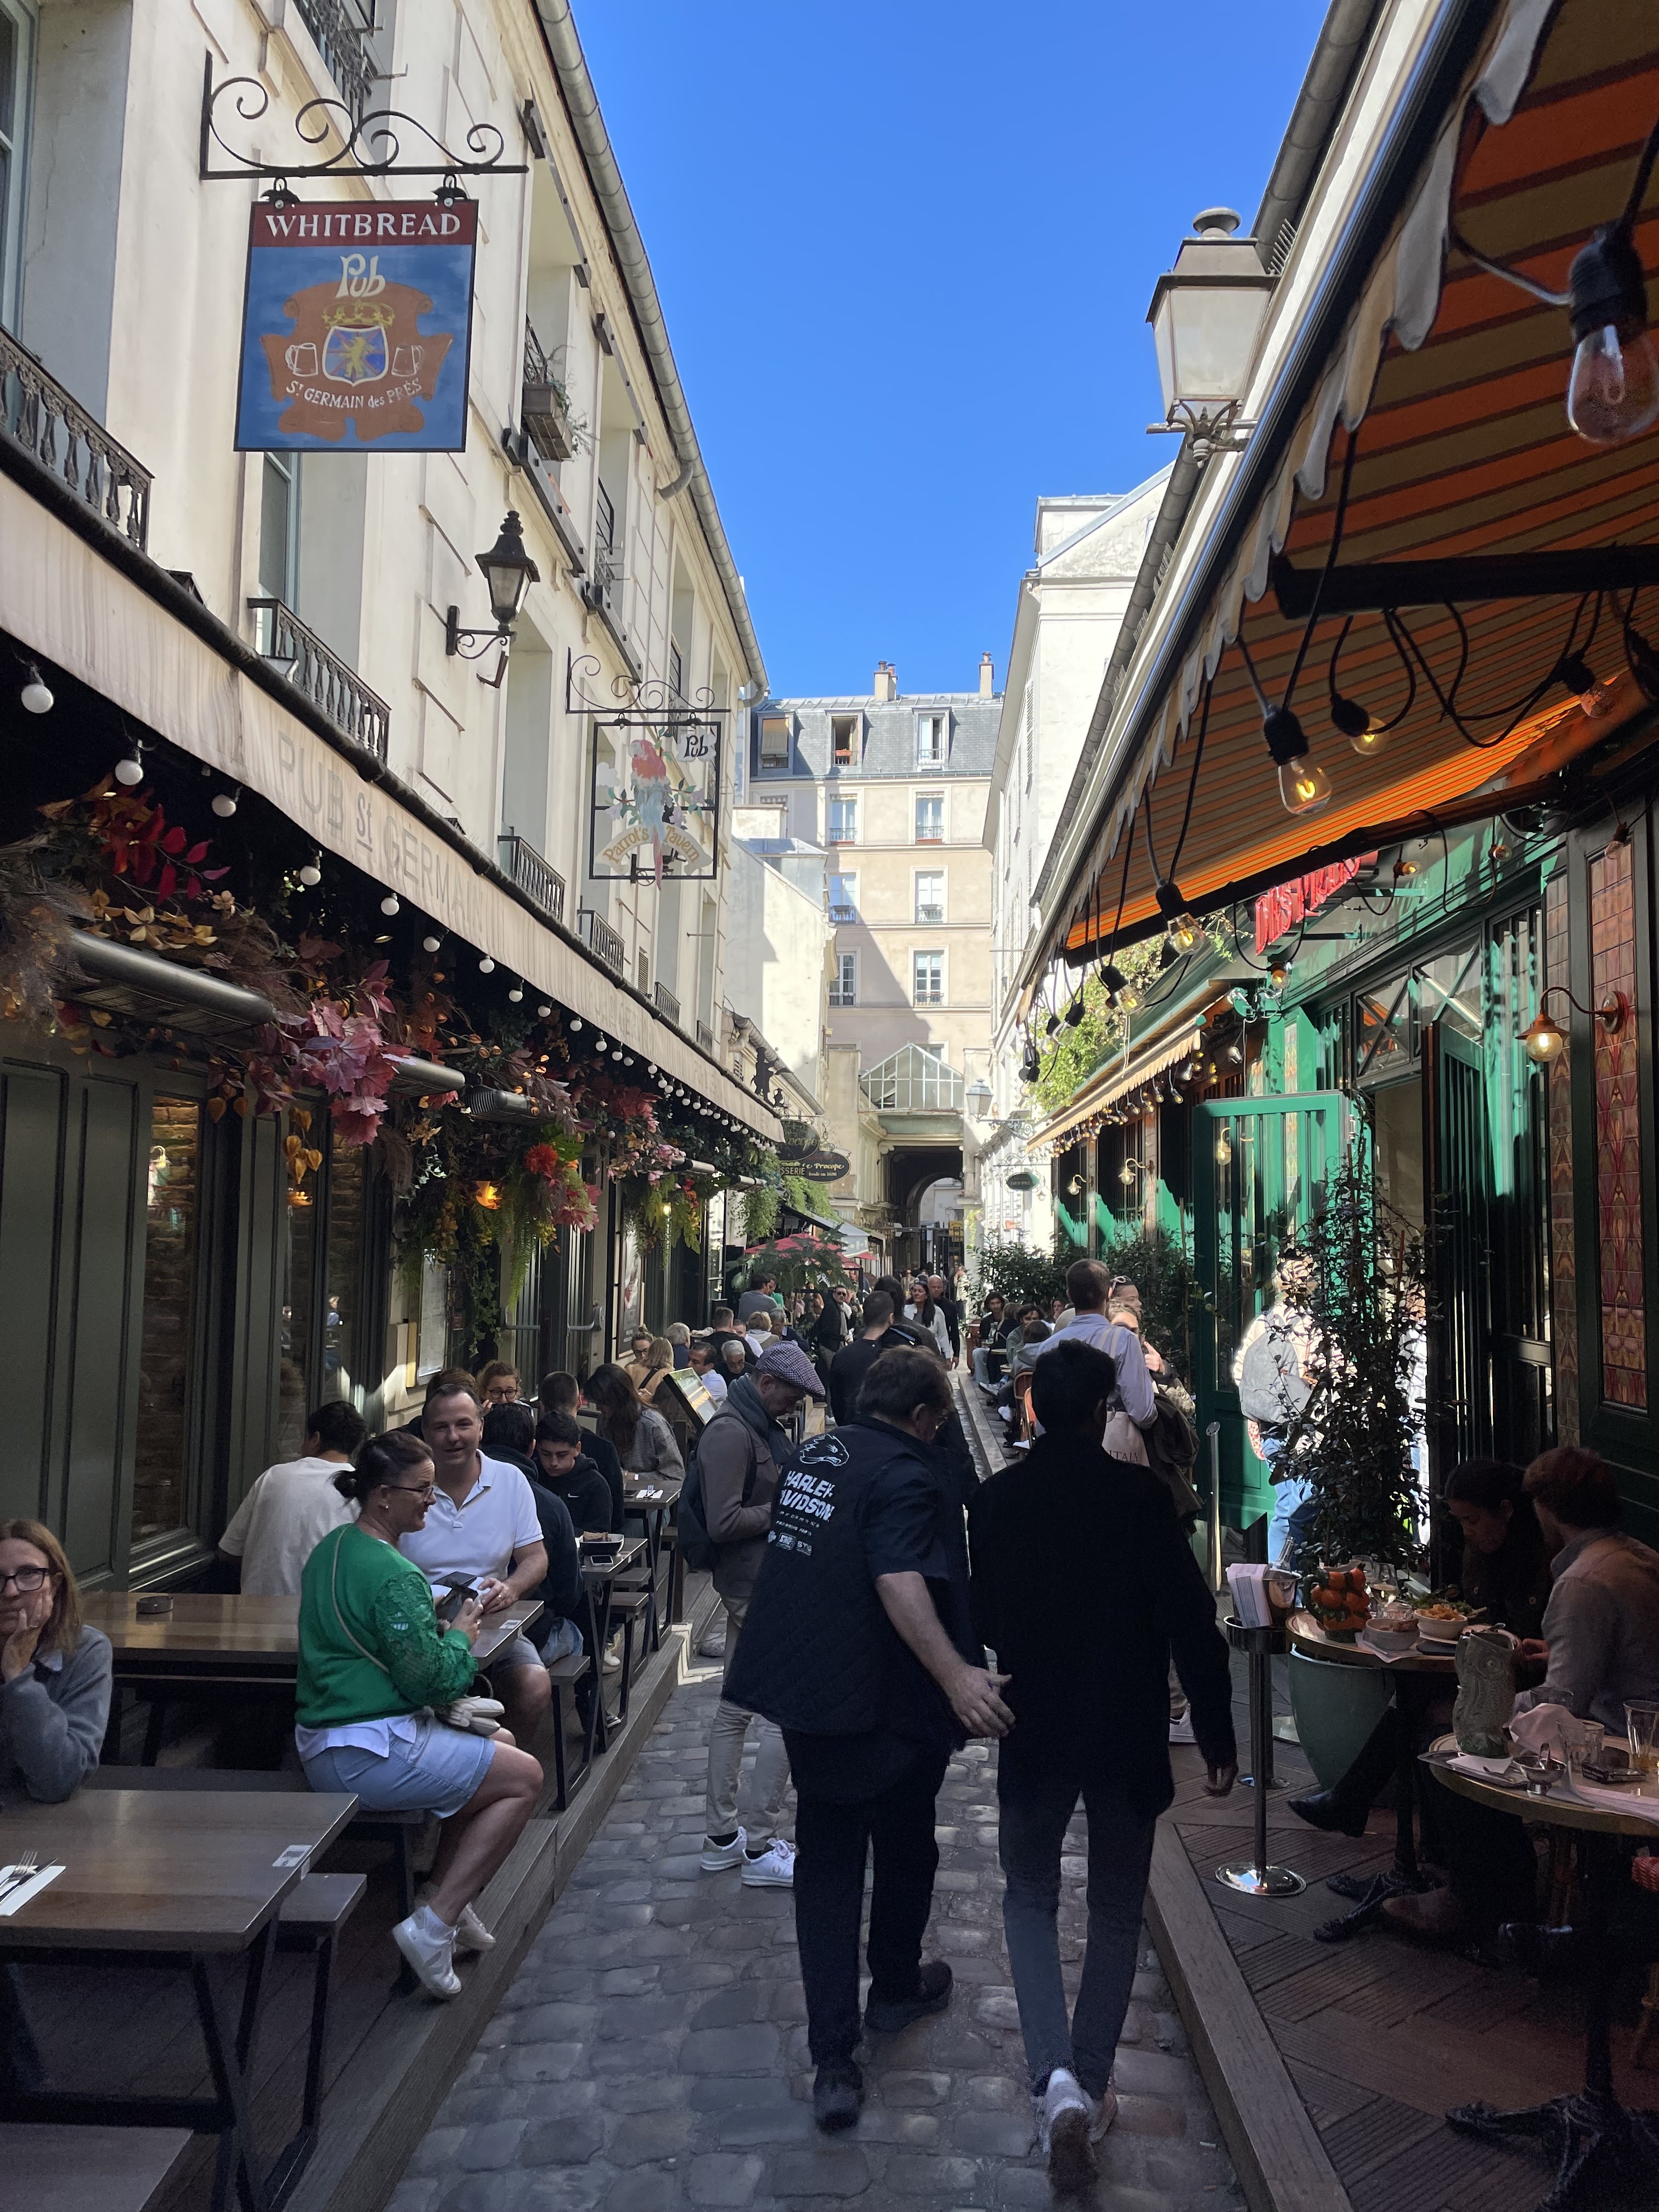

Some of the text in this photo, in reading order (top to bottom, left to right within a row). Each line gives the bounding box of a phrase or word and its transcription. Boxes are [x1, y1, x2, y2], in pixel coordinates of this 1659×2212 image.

[266, 213, 460, 237] WHITBREAD
[336, 253, 386, 298] Pub
[304, 388, 364, 409] GERMAIN
[368, 395, 385, 408] des
[386, 377, 422, 404] PRÉS
[683, 735, 708, 758] Pub
[278, 730, 345, 831] PUB
[356, 792, 373, 852] St
[603, 825, 700, 864] Parrot's Tavern
[814, 1163, 845, 1171] Procope
